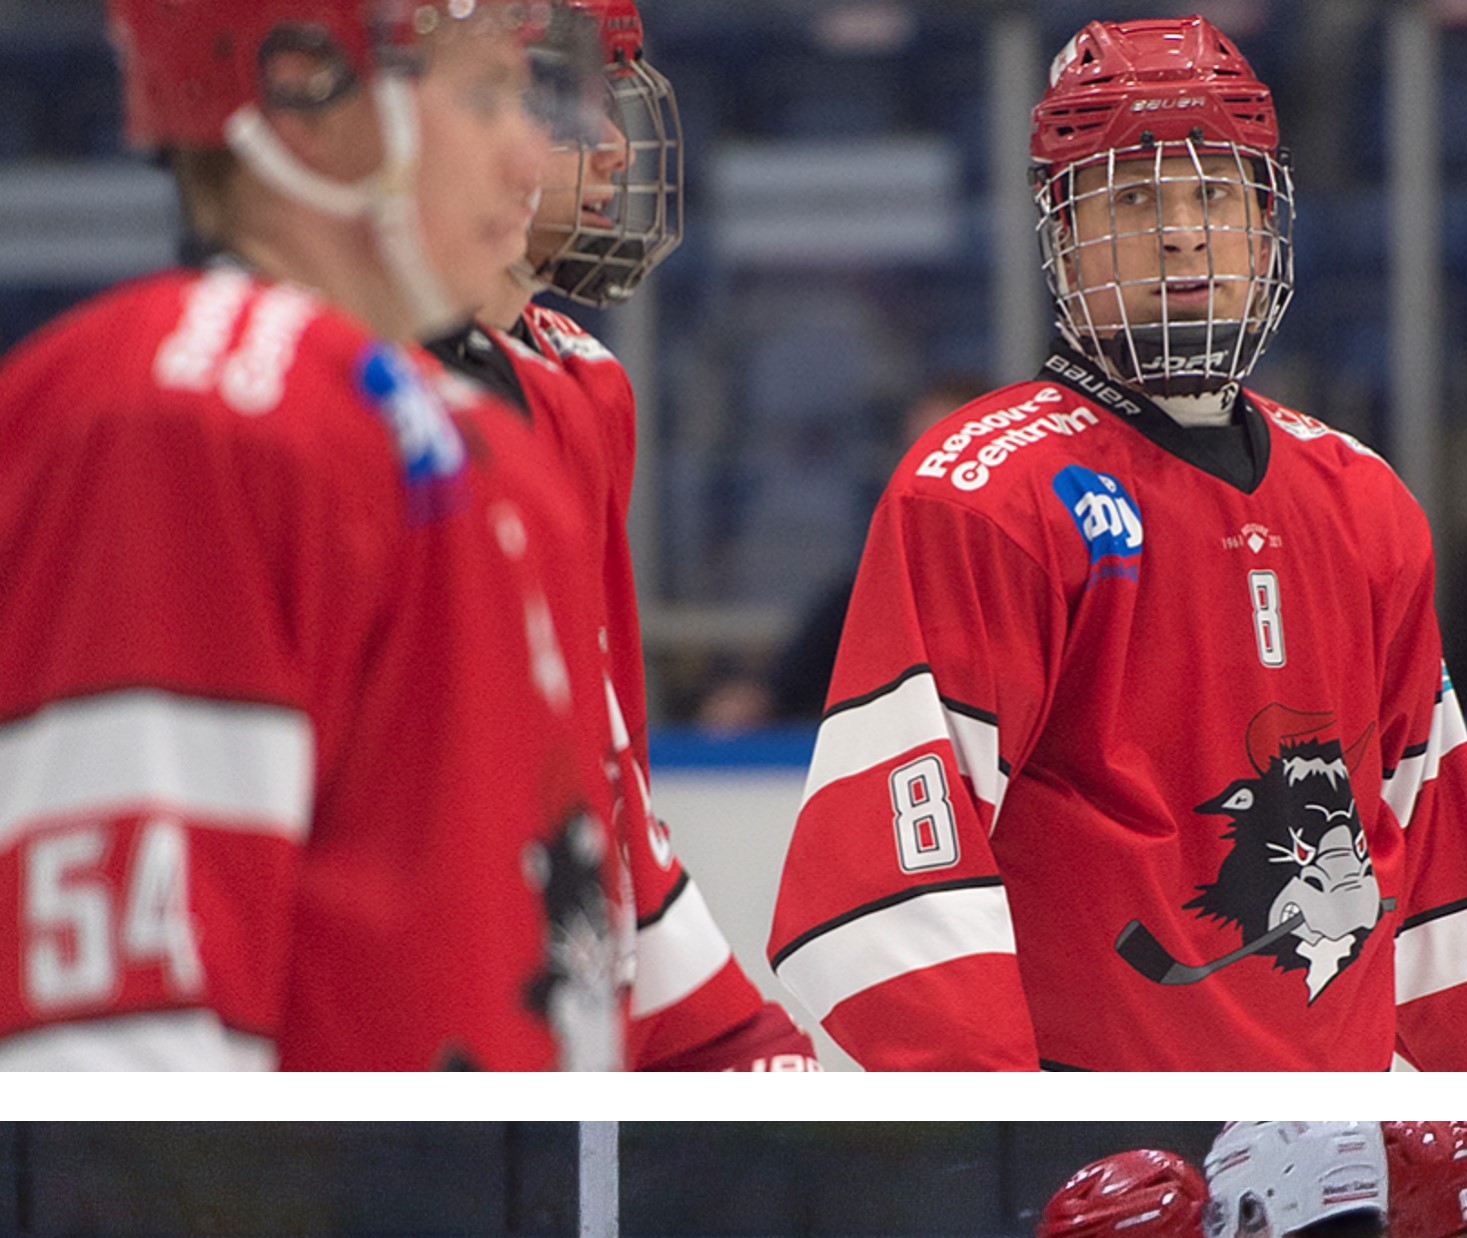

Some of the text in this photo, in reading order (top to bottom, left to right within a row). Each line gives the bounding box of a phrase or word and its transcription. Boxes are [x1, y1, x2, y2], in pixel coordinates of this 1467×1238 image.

[1248, 569, 1287, 669] 8
[889, 754, 960, 874] 8
[22, 815, 206, 1012] 54
